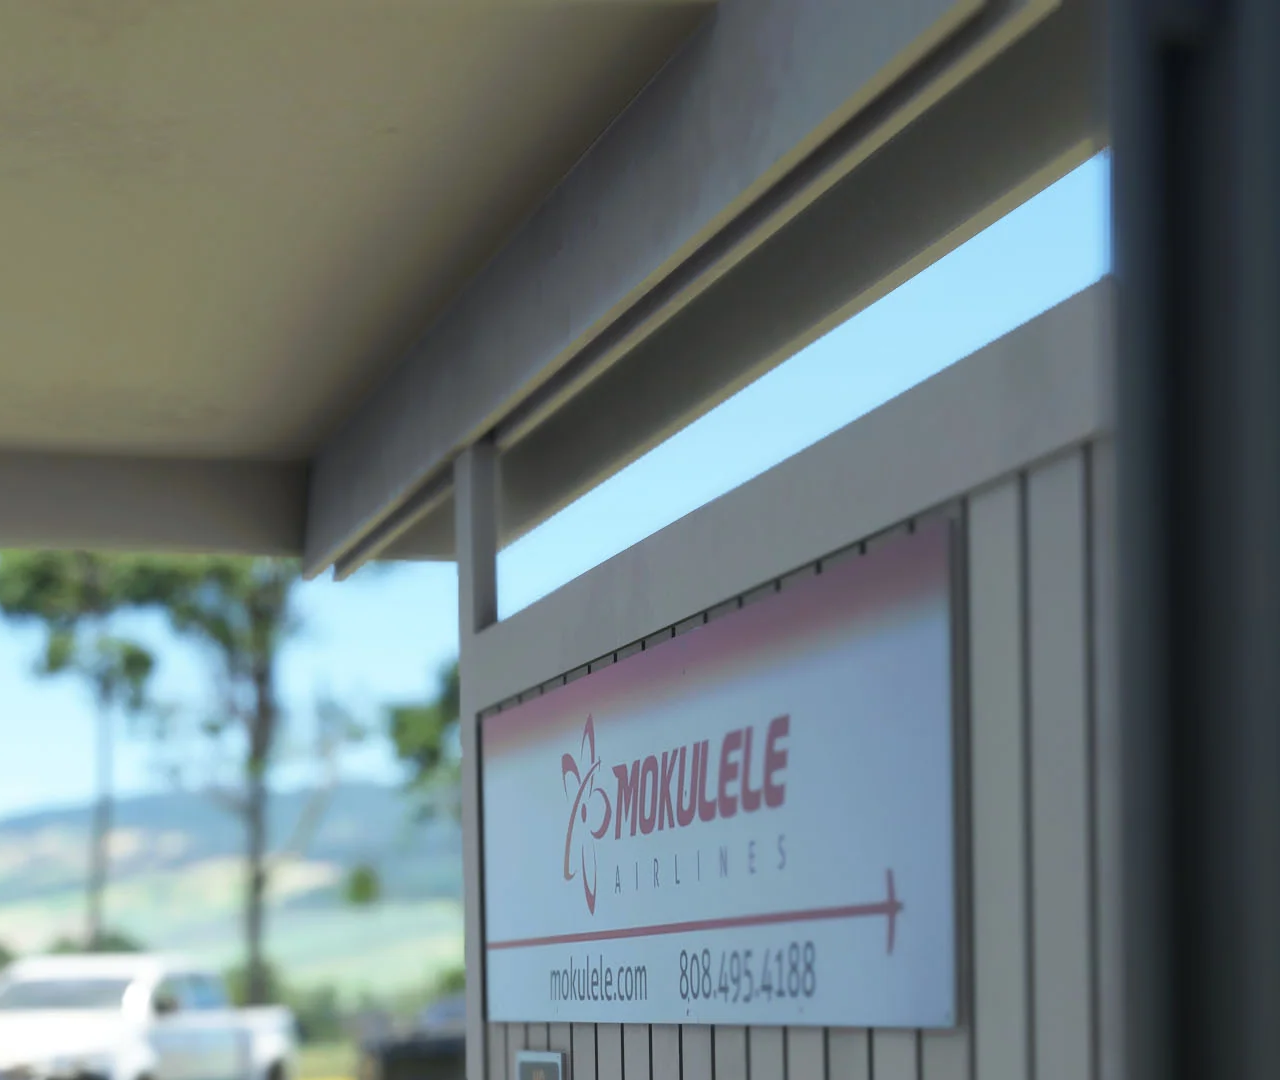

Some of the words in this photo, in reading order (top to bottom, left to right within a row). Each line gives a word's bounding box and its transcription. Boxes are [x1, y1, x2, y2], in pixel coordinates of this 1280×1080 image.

[612, 714, 791, 840] MOKULELE
[614, 834, 788, 894] AIRLINES
[550, 955, 648, 1003] mokulele.com
[679, 942, 817, 1004] 808.495.4188
